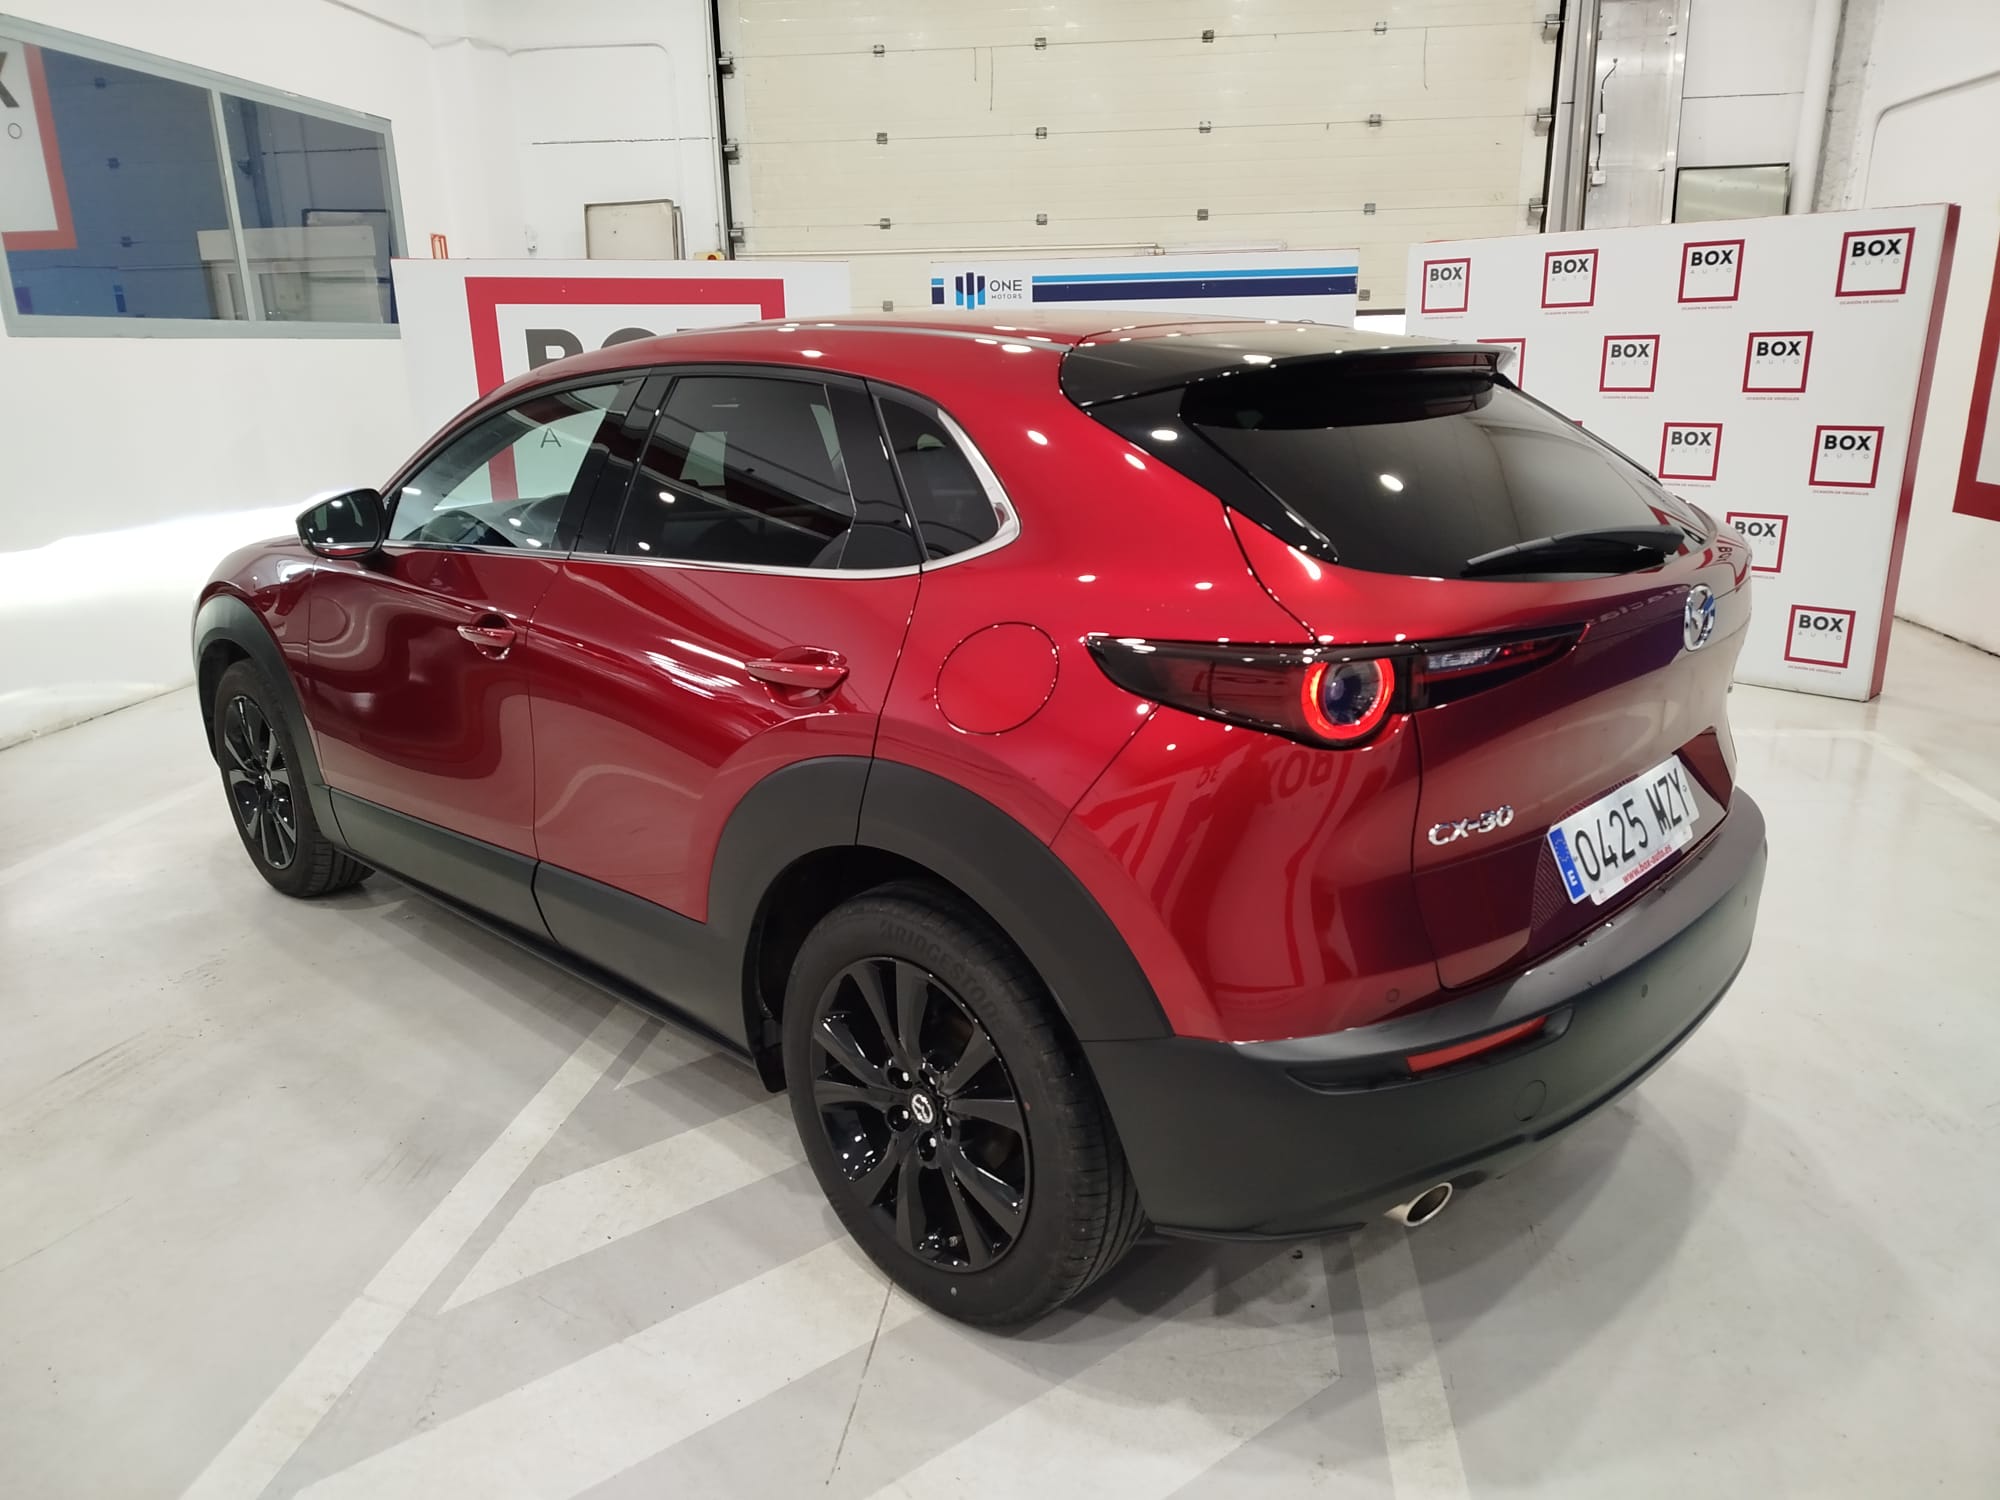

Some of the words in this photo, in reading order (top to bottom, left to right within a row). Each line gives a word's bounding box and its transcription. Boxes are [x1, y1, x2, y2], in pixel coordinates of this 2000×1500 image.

[1851, 238, 1902, 257] BOX
[1551, 258, 1589, 274] BOX
[1690, 250, 1734, 266] BOX
[1429, 266, 1462, 282] BOX
[989, 279, 1023, 292] ONE
[1611, 343, 1650, 358] BOX
[1756, 341, 1802, 357] BOX
[1671, 431, 1713, 446] BOX
[1823, 435, 1872, 451] BOX
[1734, 521, 1777, 538] BOX
[1798, 614, 1845, 633] BOX
[1428, 805, 1514, 845] CX-30
[1575, 798, 1649, 882] 0425
[1645, 767, 1690, 836] MZY
[1622, 844, 1673, 884] www.box-auto.es
[1567, 869, 1578, 887] E
